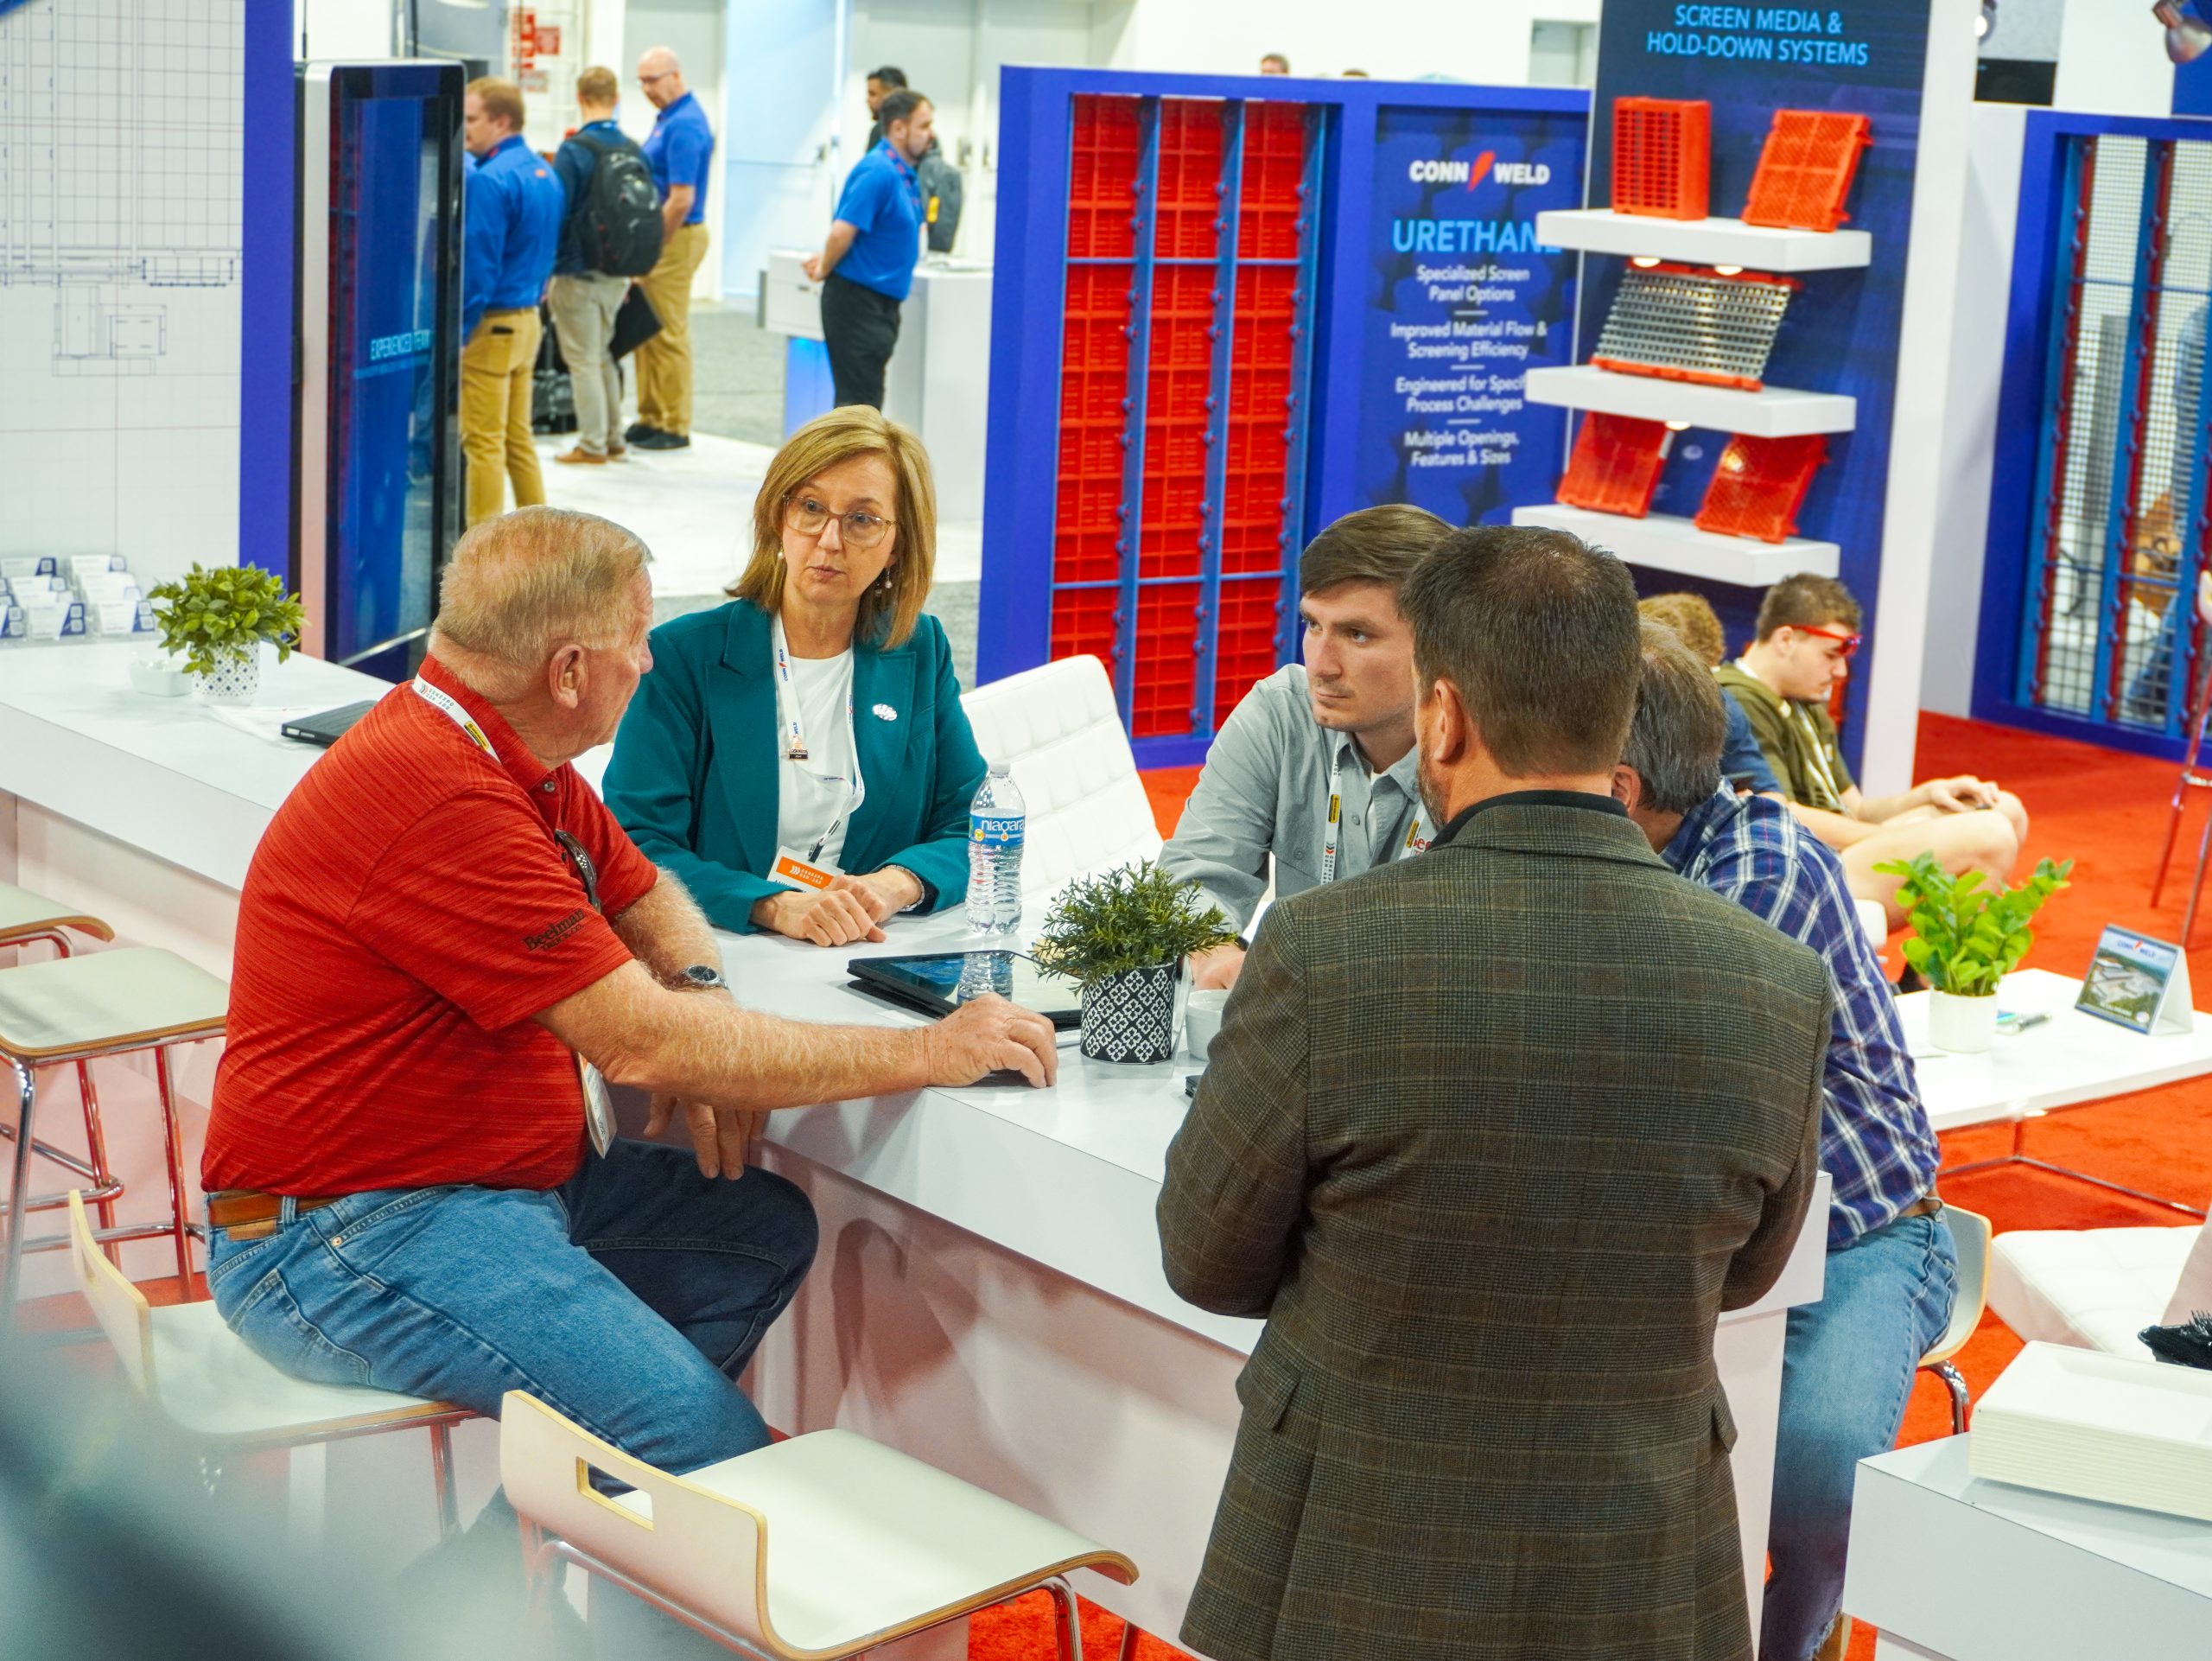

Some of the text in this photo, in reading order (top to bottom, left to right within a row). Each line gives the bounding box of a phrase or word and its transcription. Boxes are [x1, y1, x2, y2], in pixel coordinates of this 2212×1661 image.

[1675, 3, 1843, 35] SCREEN MEDIA &
[1646, 30, 1869, 66] HOLD-DOWN SYSTEMS
[1409, 160, 1551, 185] CONN WELD
[1392, 220, 1562, 253] URETHAN
[1416, 264, 1530, 285] Specialized Screen
[1428, 284, 1516, 305] Panel Options
[1390, 321, 1548, 342] Improved Material Flow &
[1408, 340, 1529, 361] Screening Efficiency
[1395, 376, 1467, 396] Engineered
[1468, 374, 1487, 391] for
[1406, 395, 1523, 415] Process Challenges
[1404, 430, 1520, 450] Multiple Openings,
[1410, 449, 1511, 467] Features & Sizes
[981, 819, 1024, 832] niagara
[522, 908, 586, 951] Beelman
